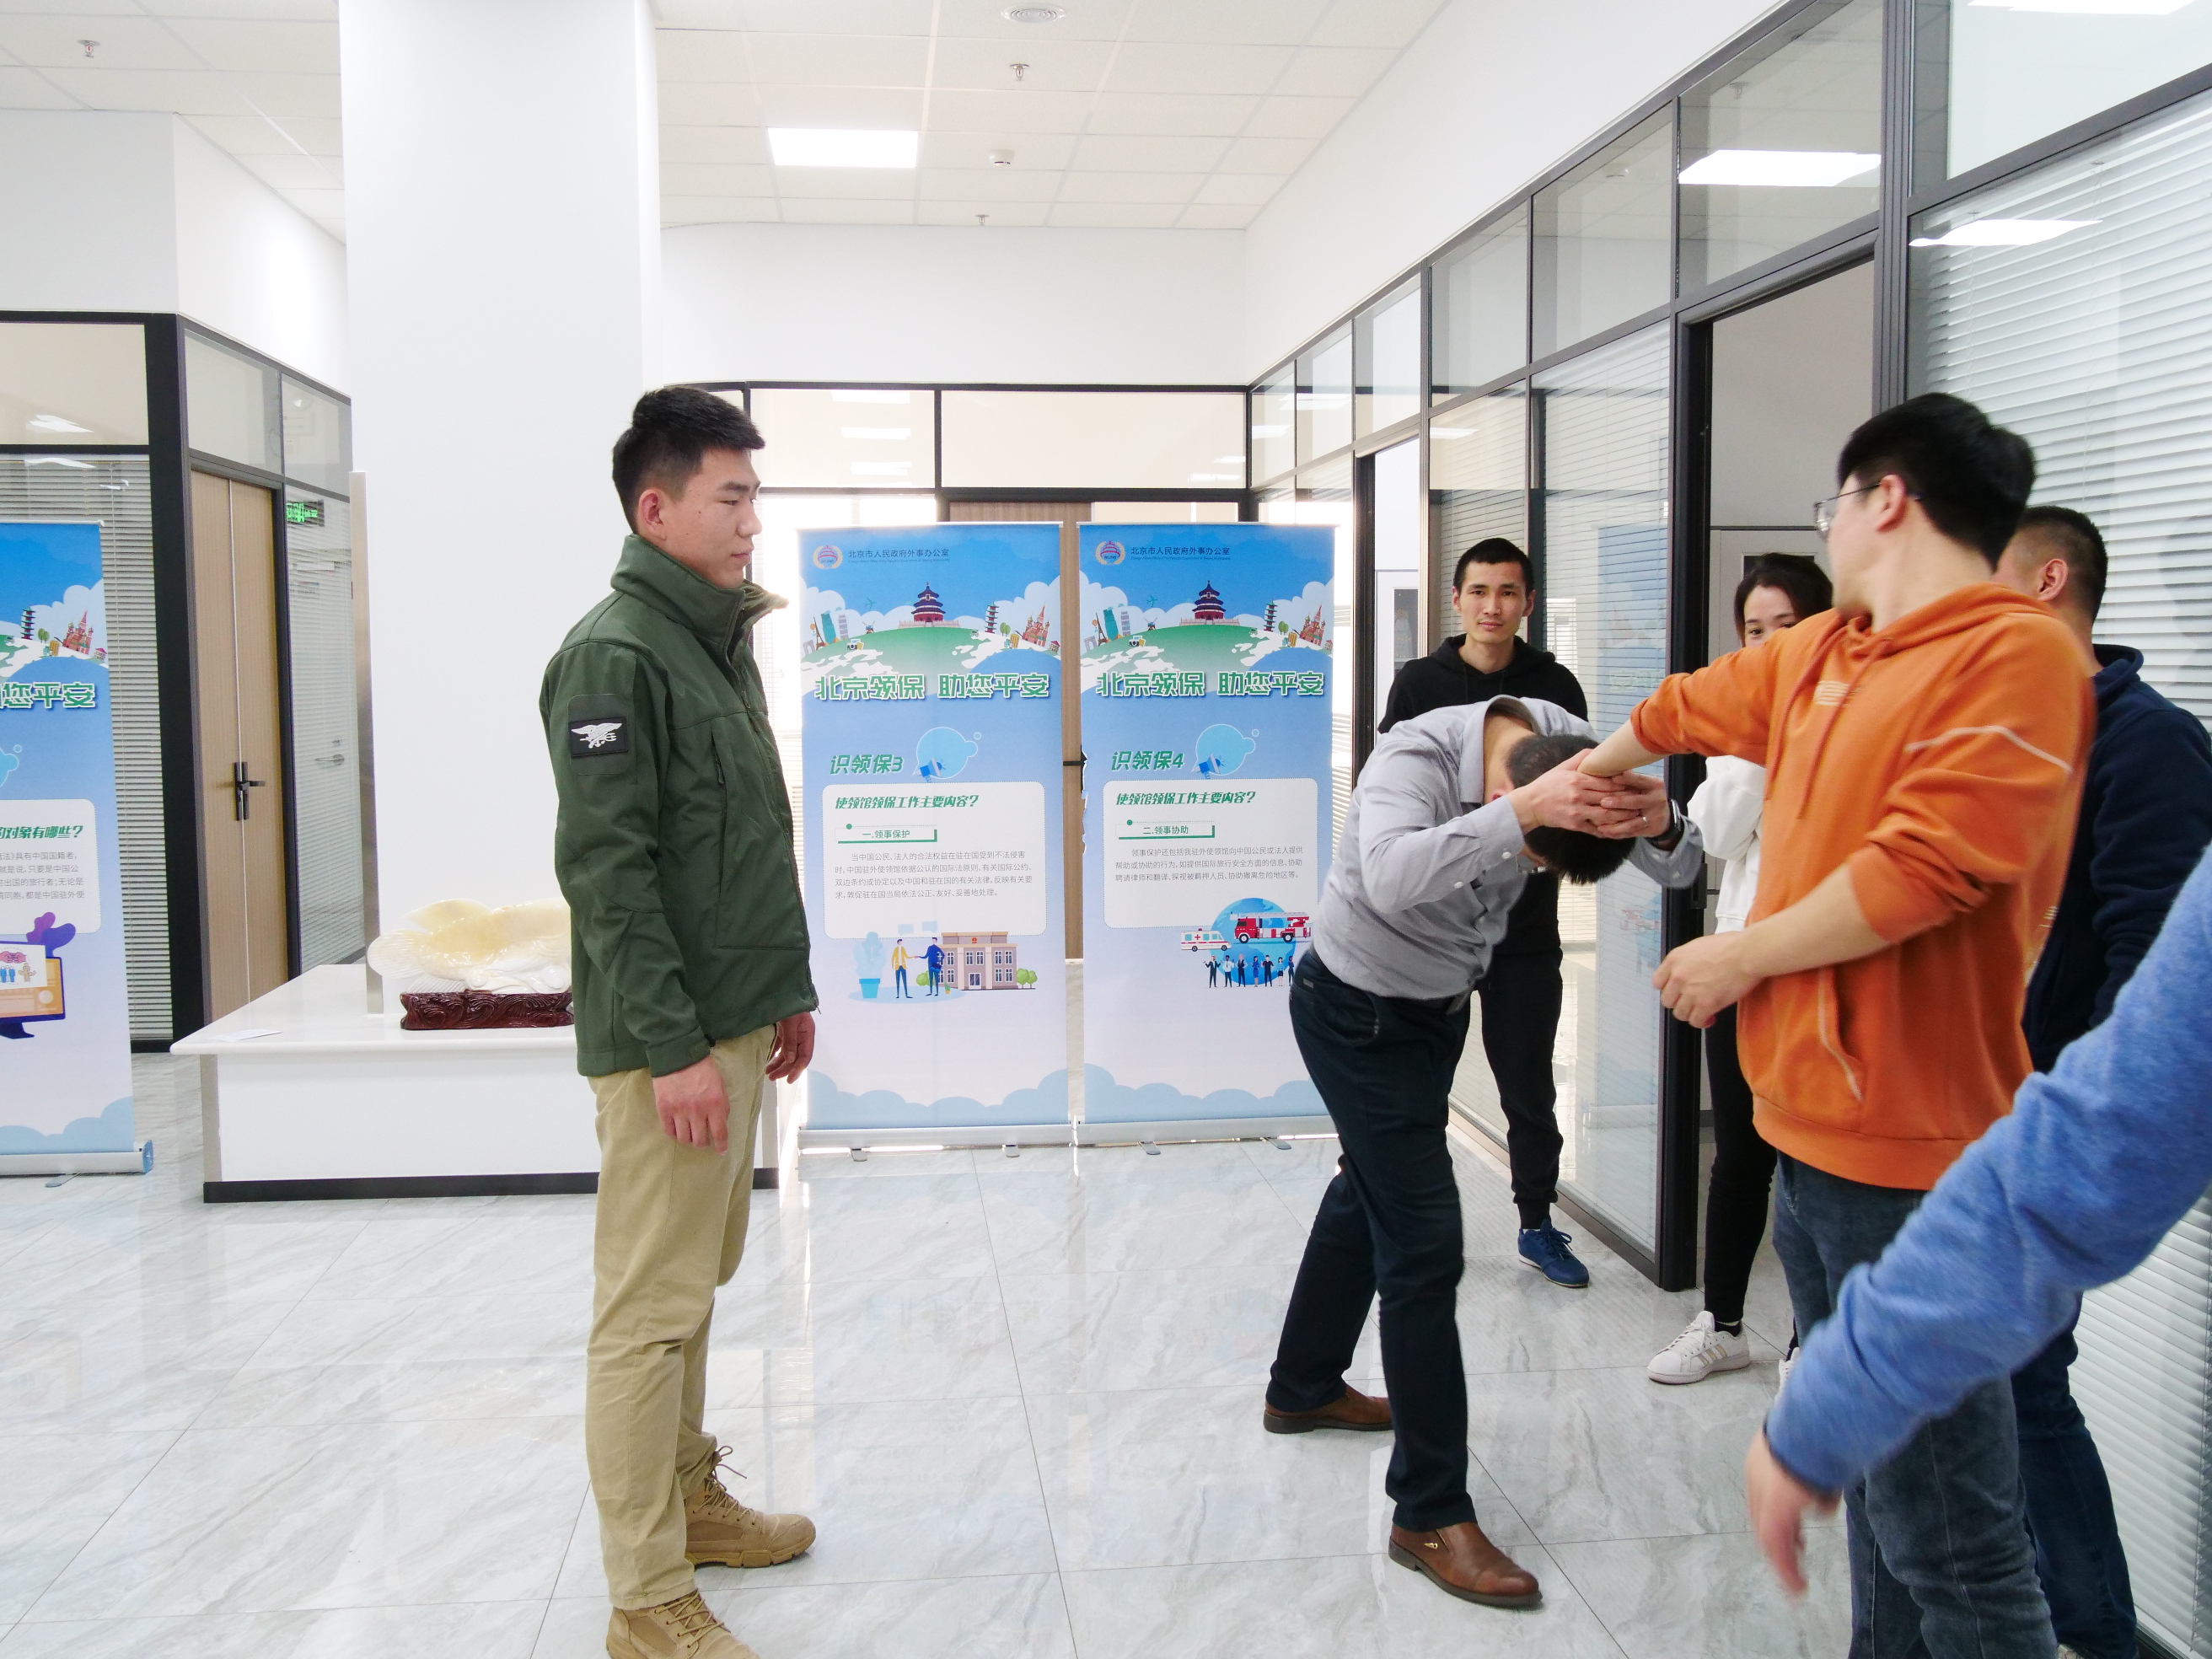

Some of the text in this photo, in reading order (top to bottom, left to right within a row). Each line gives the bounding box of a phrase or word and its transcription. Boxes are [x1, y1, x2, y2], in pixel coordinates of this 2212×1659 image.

[848, 549, 949, 558] 北京市人民政府外事办公室
[1130, 546, 1231, 556] 北京市人民政府外事办公室
[814, 674, 1050, 701] 北京领保 助您平安
[1096, 670, 1324, 698] 北京领保 助您平安
[0, 682, 96, 709] 您平安
[830, 754, 904, 776] 识领保3
[1111, 751, 1184, 771] 识领保4
[835, 794, 980, 810] 使领馆领保工作主要内容?
[1115, 791, 1257, 807] 使领馆领保工作主要内容?
